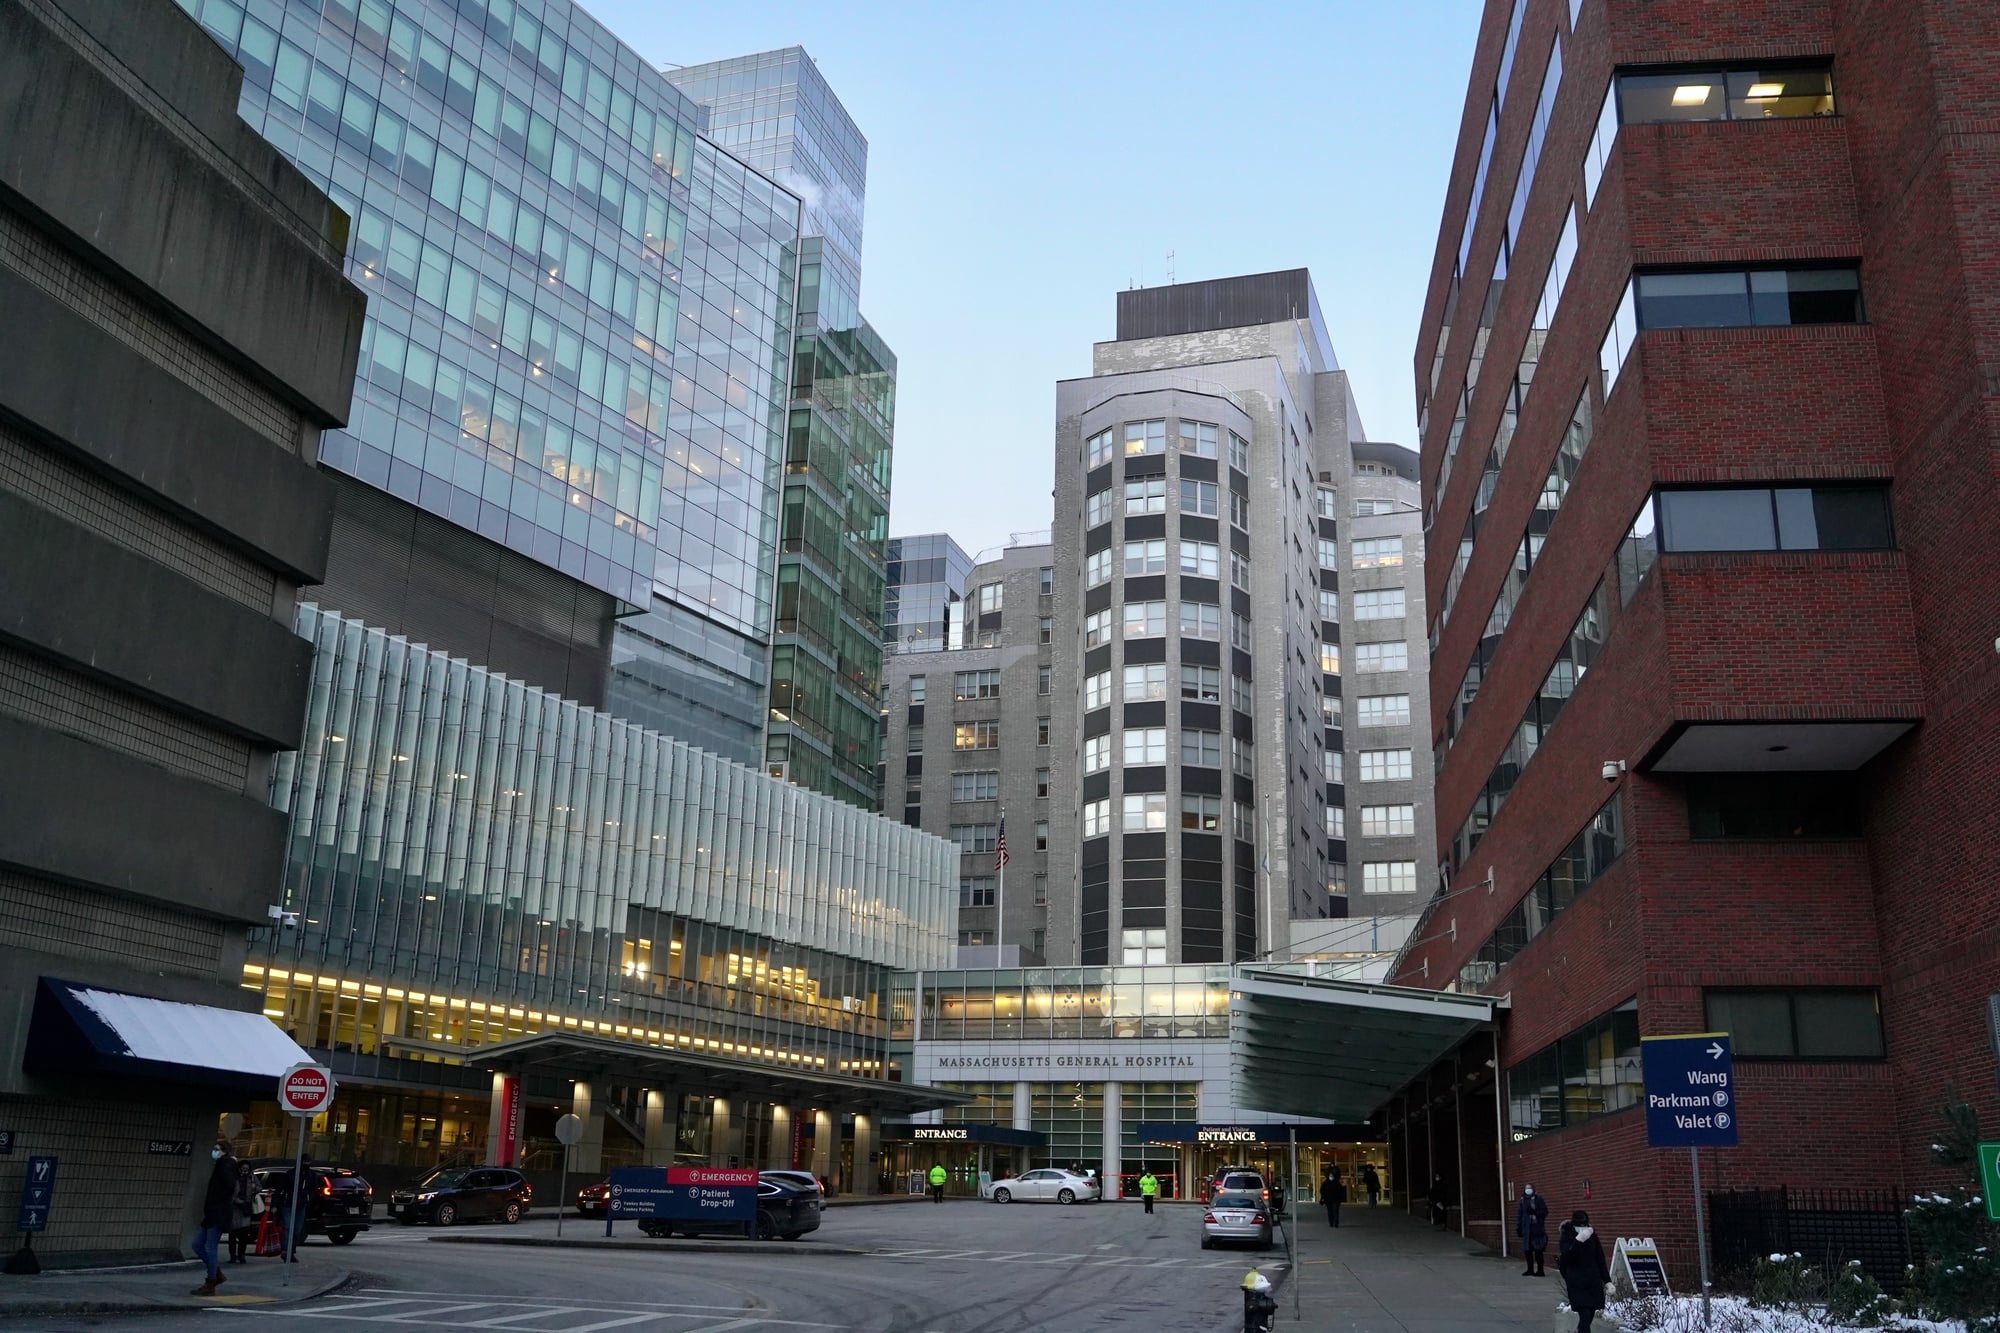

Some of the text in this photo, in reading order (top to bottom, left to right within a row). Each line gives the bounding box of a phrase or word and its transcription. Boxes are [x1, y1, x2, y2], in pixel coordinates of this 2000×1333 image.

[938, 1056, 1195, 1067] MASSACHUSETTS GENERAL HOSPITAL
[1687, 1071, 1727, 1087] Wang
[292, 1092, 319, 1100] ENTER
[1649, 1093, 1710, 1108] Parkman
[508, 1083, 520, 1141] EMERGENCY
[1675, 1114, 1712, 1129] Valet
[914, 1129, 967, 1139] ENTRANCE
[1198, 1131, 1256, 1141] ENTRANCE
[150, 1142, 173, 1153] Stairs
[701, 1173, 753, 1182] EMERGENCY
[701, 1189, 730, 1198] Patient
[701, 1199, 735, 1208] Drop-Off
